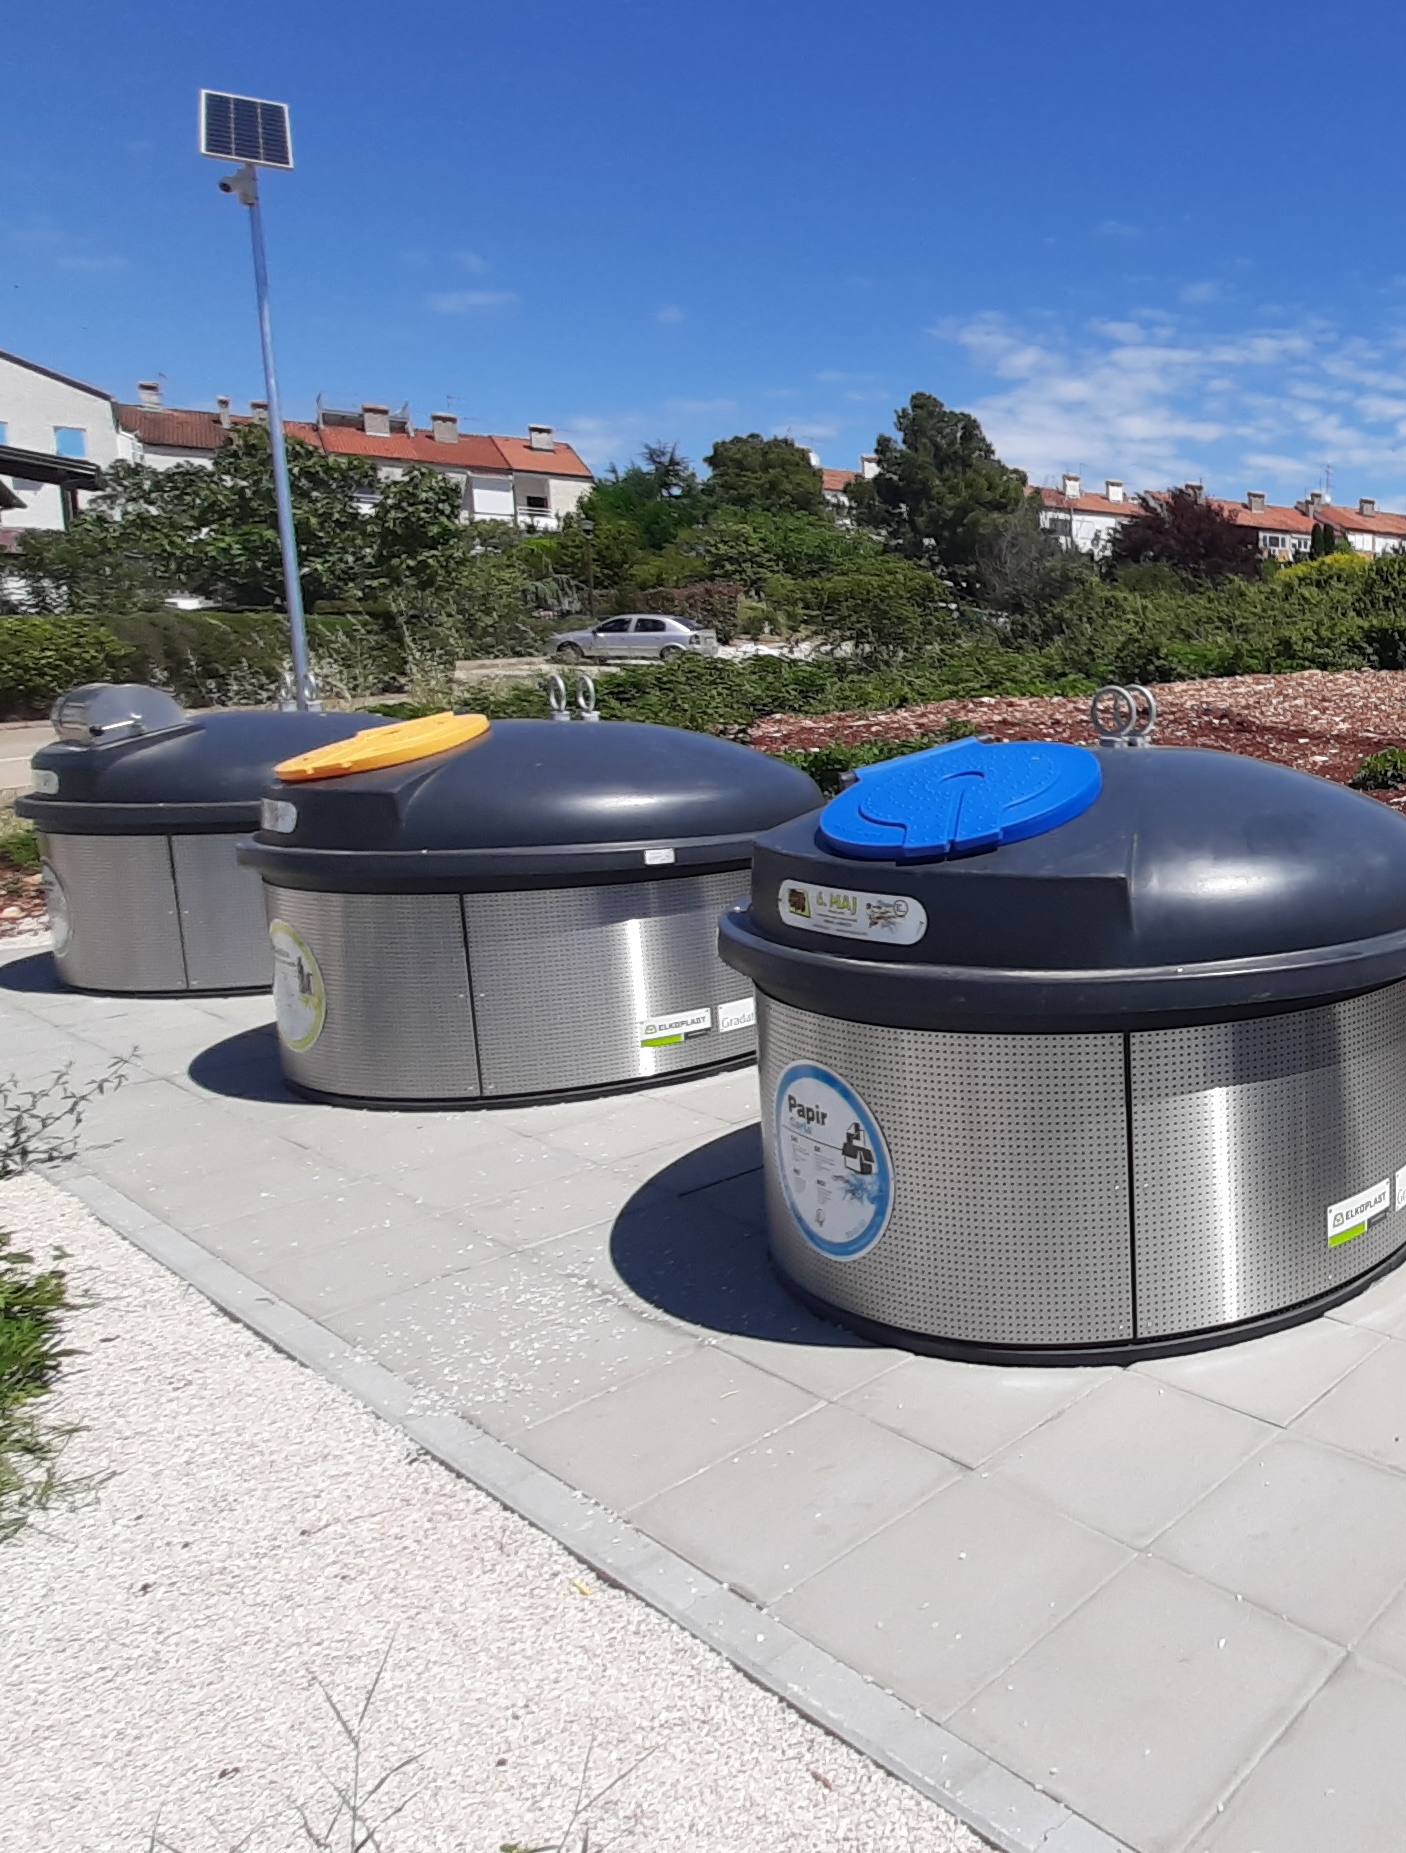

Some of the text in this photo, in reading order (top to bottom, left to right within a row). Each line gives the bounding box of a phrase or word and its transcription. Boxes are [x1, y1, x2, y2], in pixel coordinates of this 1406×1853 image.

[830, 892, 857, 915] MAJ
[787, 1093, 828, 1126] Papir
[1345, 1191, 1387, 1221] ELKOPLAST
